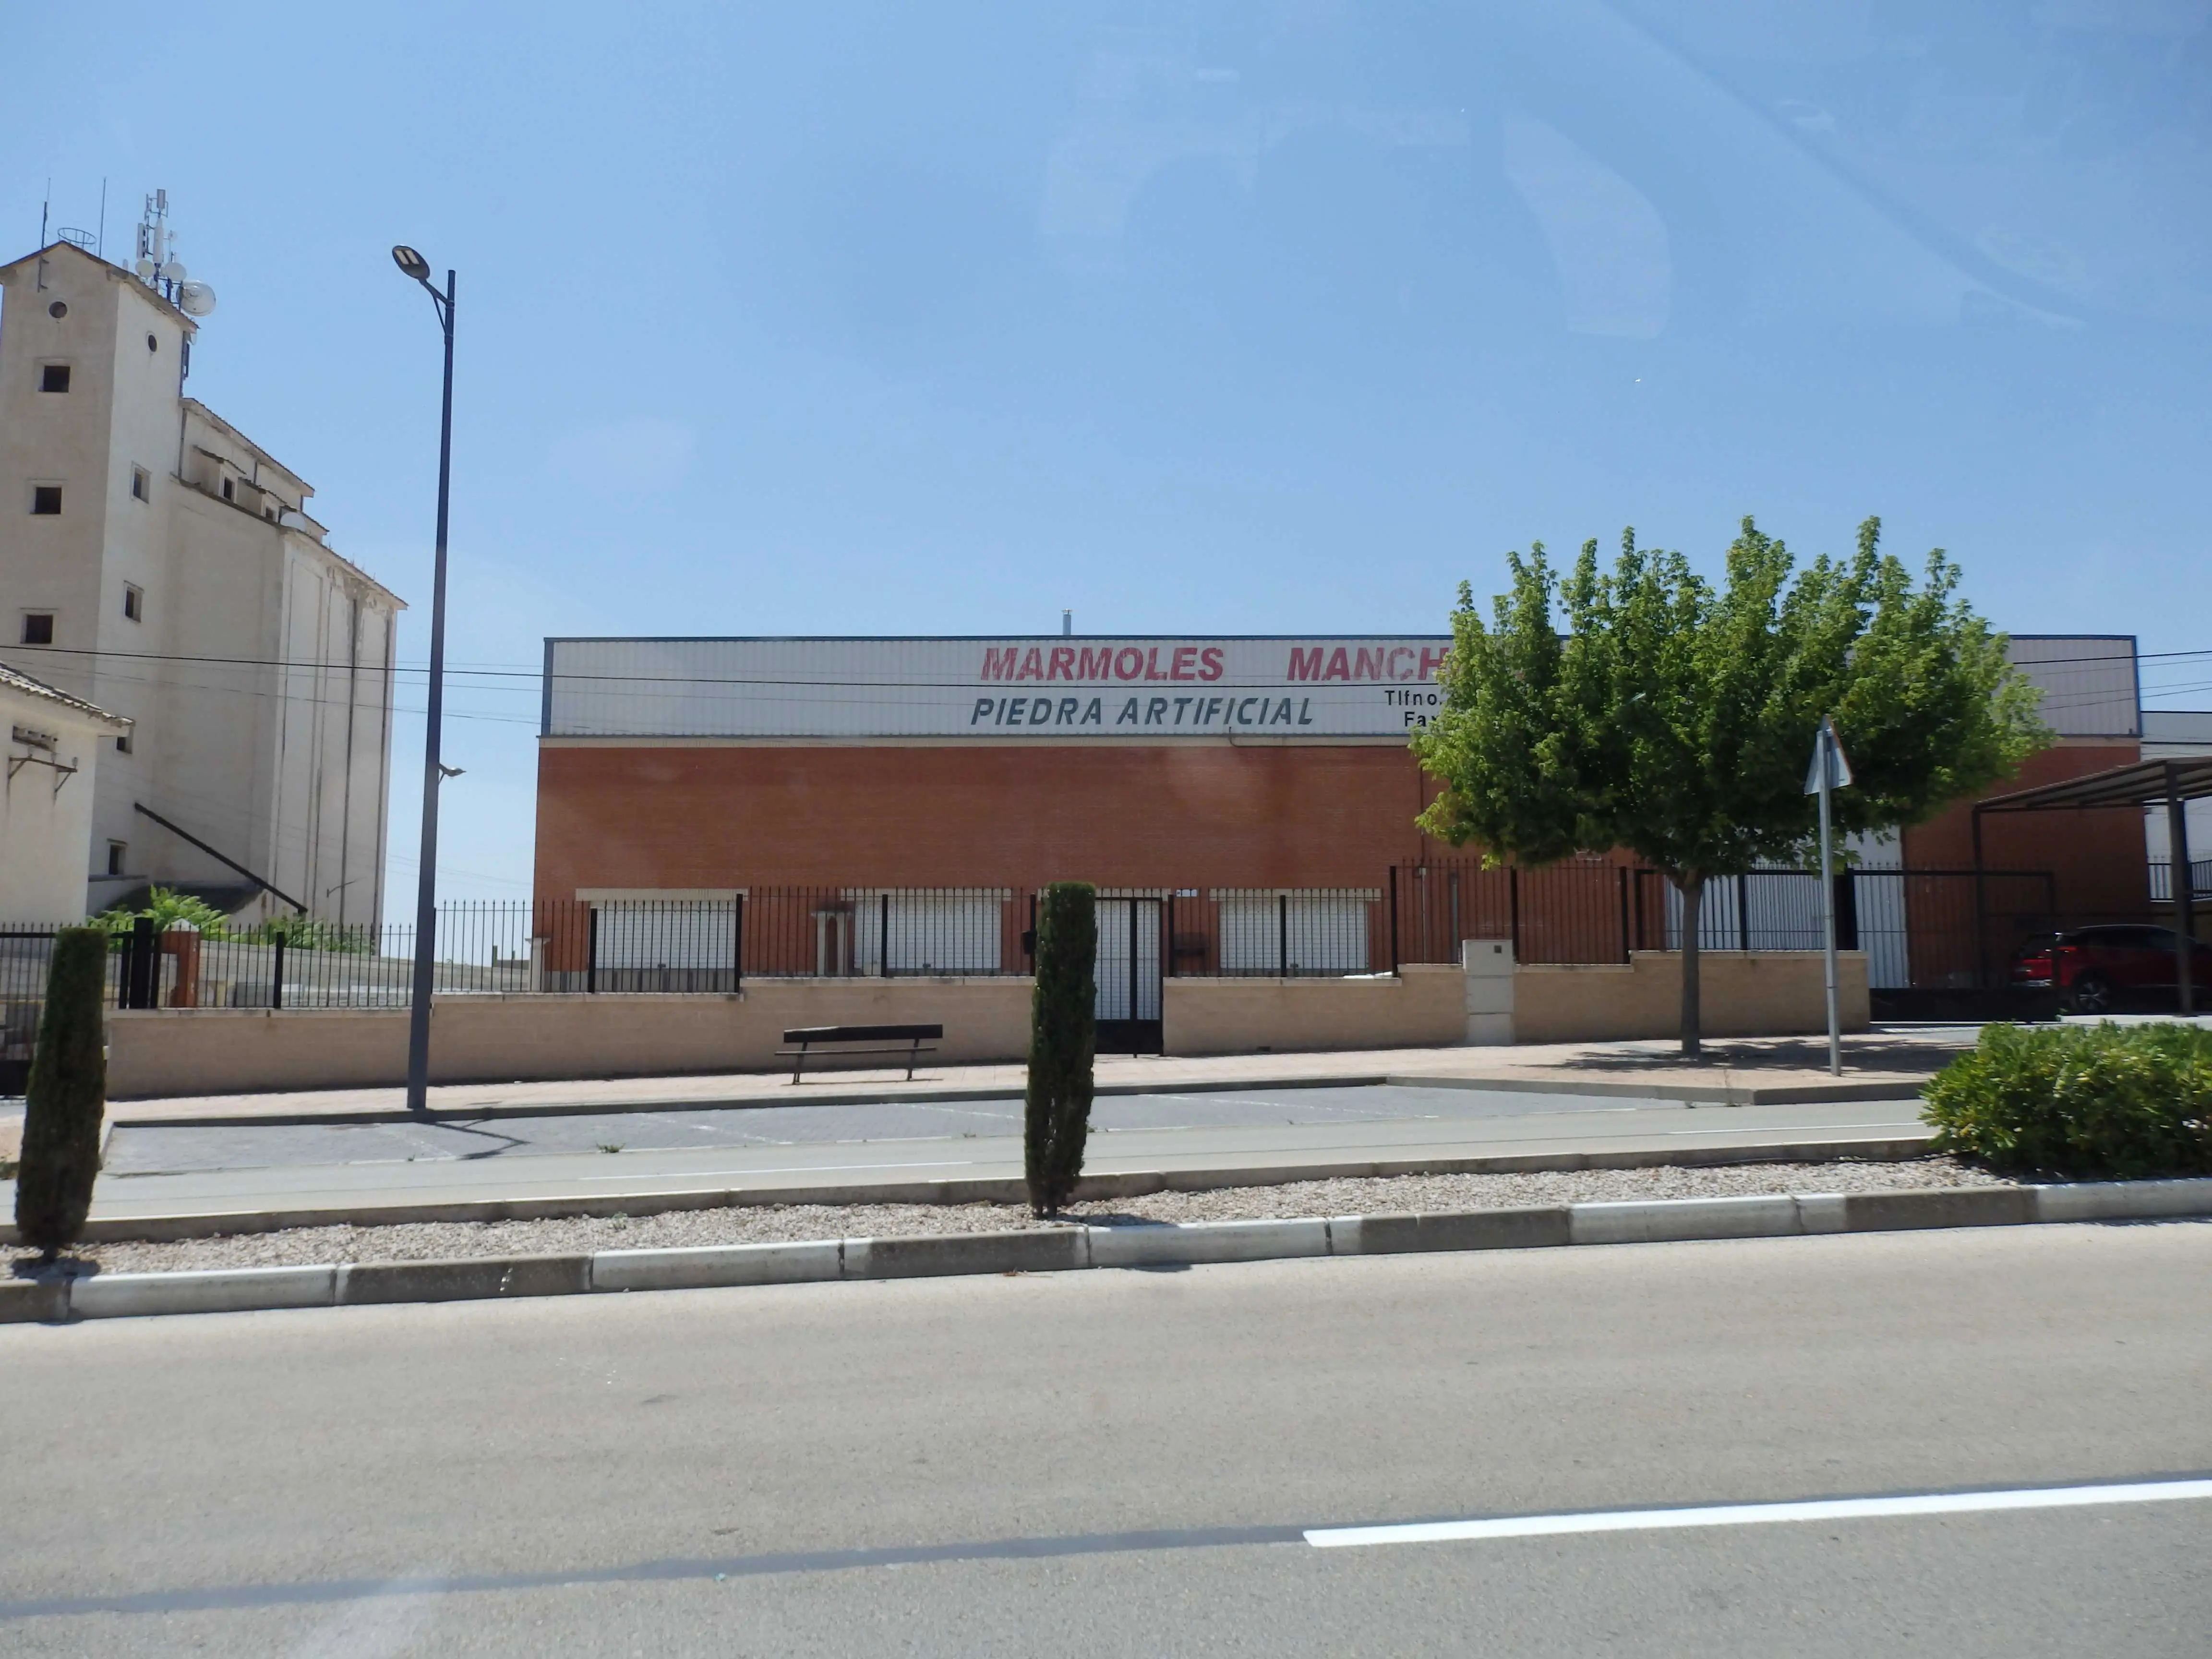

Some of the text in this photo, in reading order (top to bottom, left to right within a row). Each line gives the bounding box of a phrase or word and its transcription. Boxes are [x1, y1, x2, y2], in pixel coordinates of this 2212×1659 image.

[981, 647, 1449, 681] MARMOLES MANCH
[971, 697, 1313, 725] PIEDRA ARTIFICIAL
